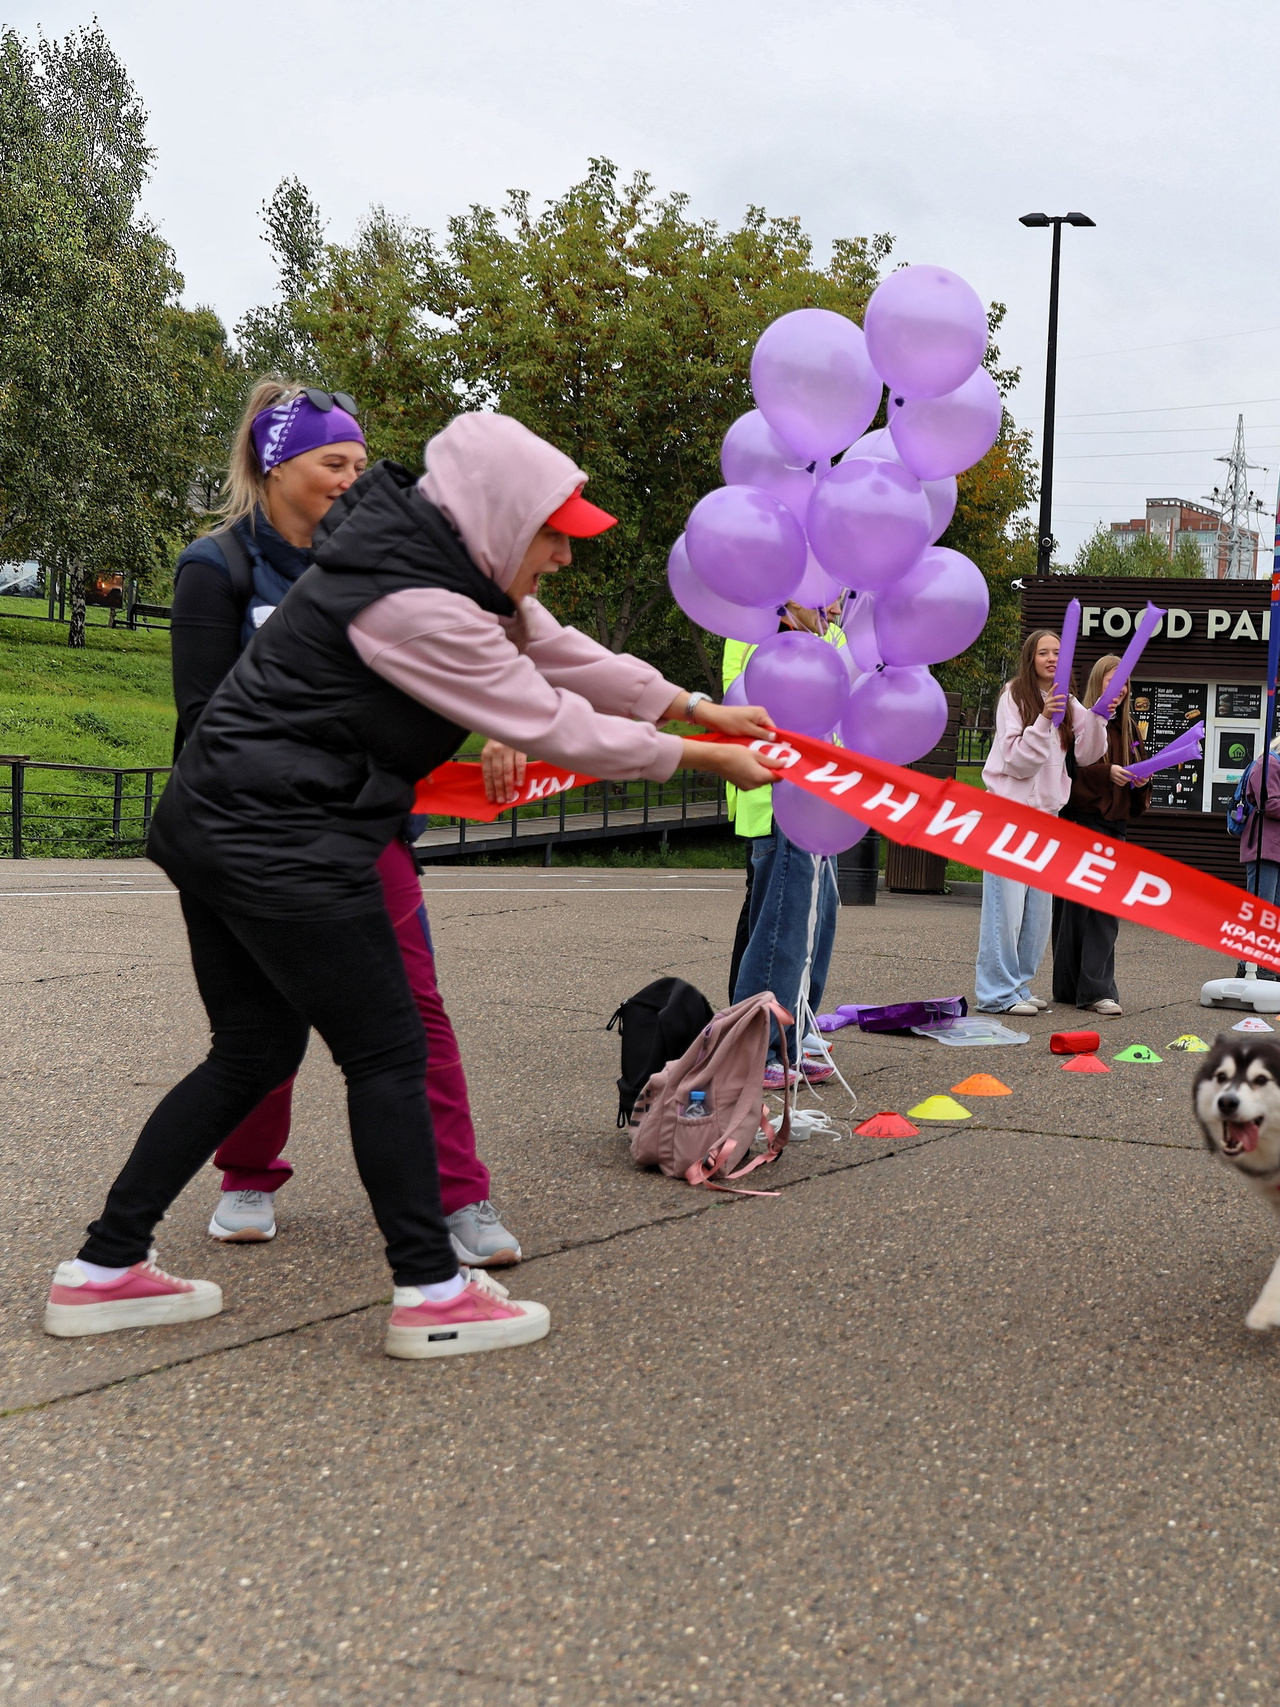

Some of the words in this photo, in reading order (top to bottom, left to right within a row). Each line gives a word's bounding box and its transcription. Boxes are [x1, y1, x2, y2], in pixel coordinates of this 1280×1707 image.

[274, 399, 303, 467] СМАРАФОН
[1081, 606, 1193, 639] FOOD
[526, 774, 576, 800] КМ
[748, 739, 1173, 907] ФИНИШЁР
[1237, 901, 1254, 922] 5
